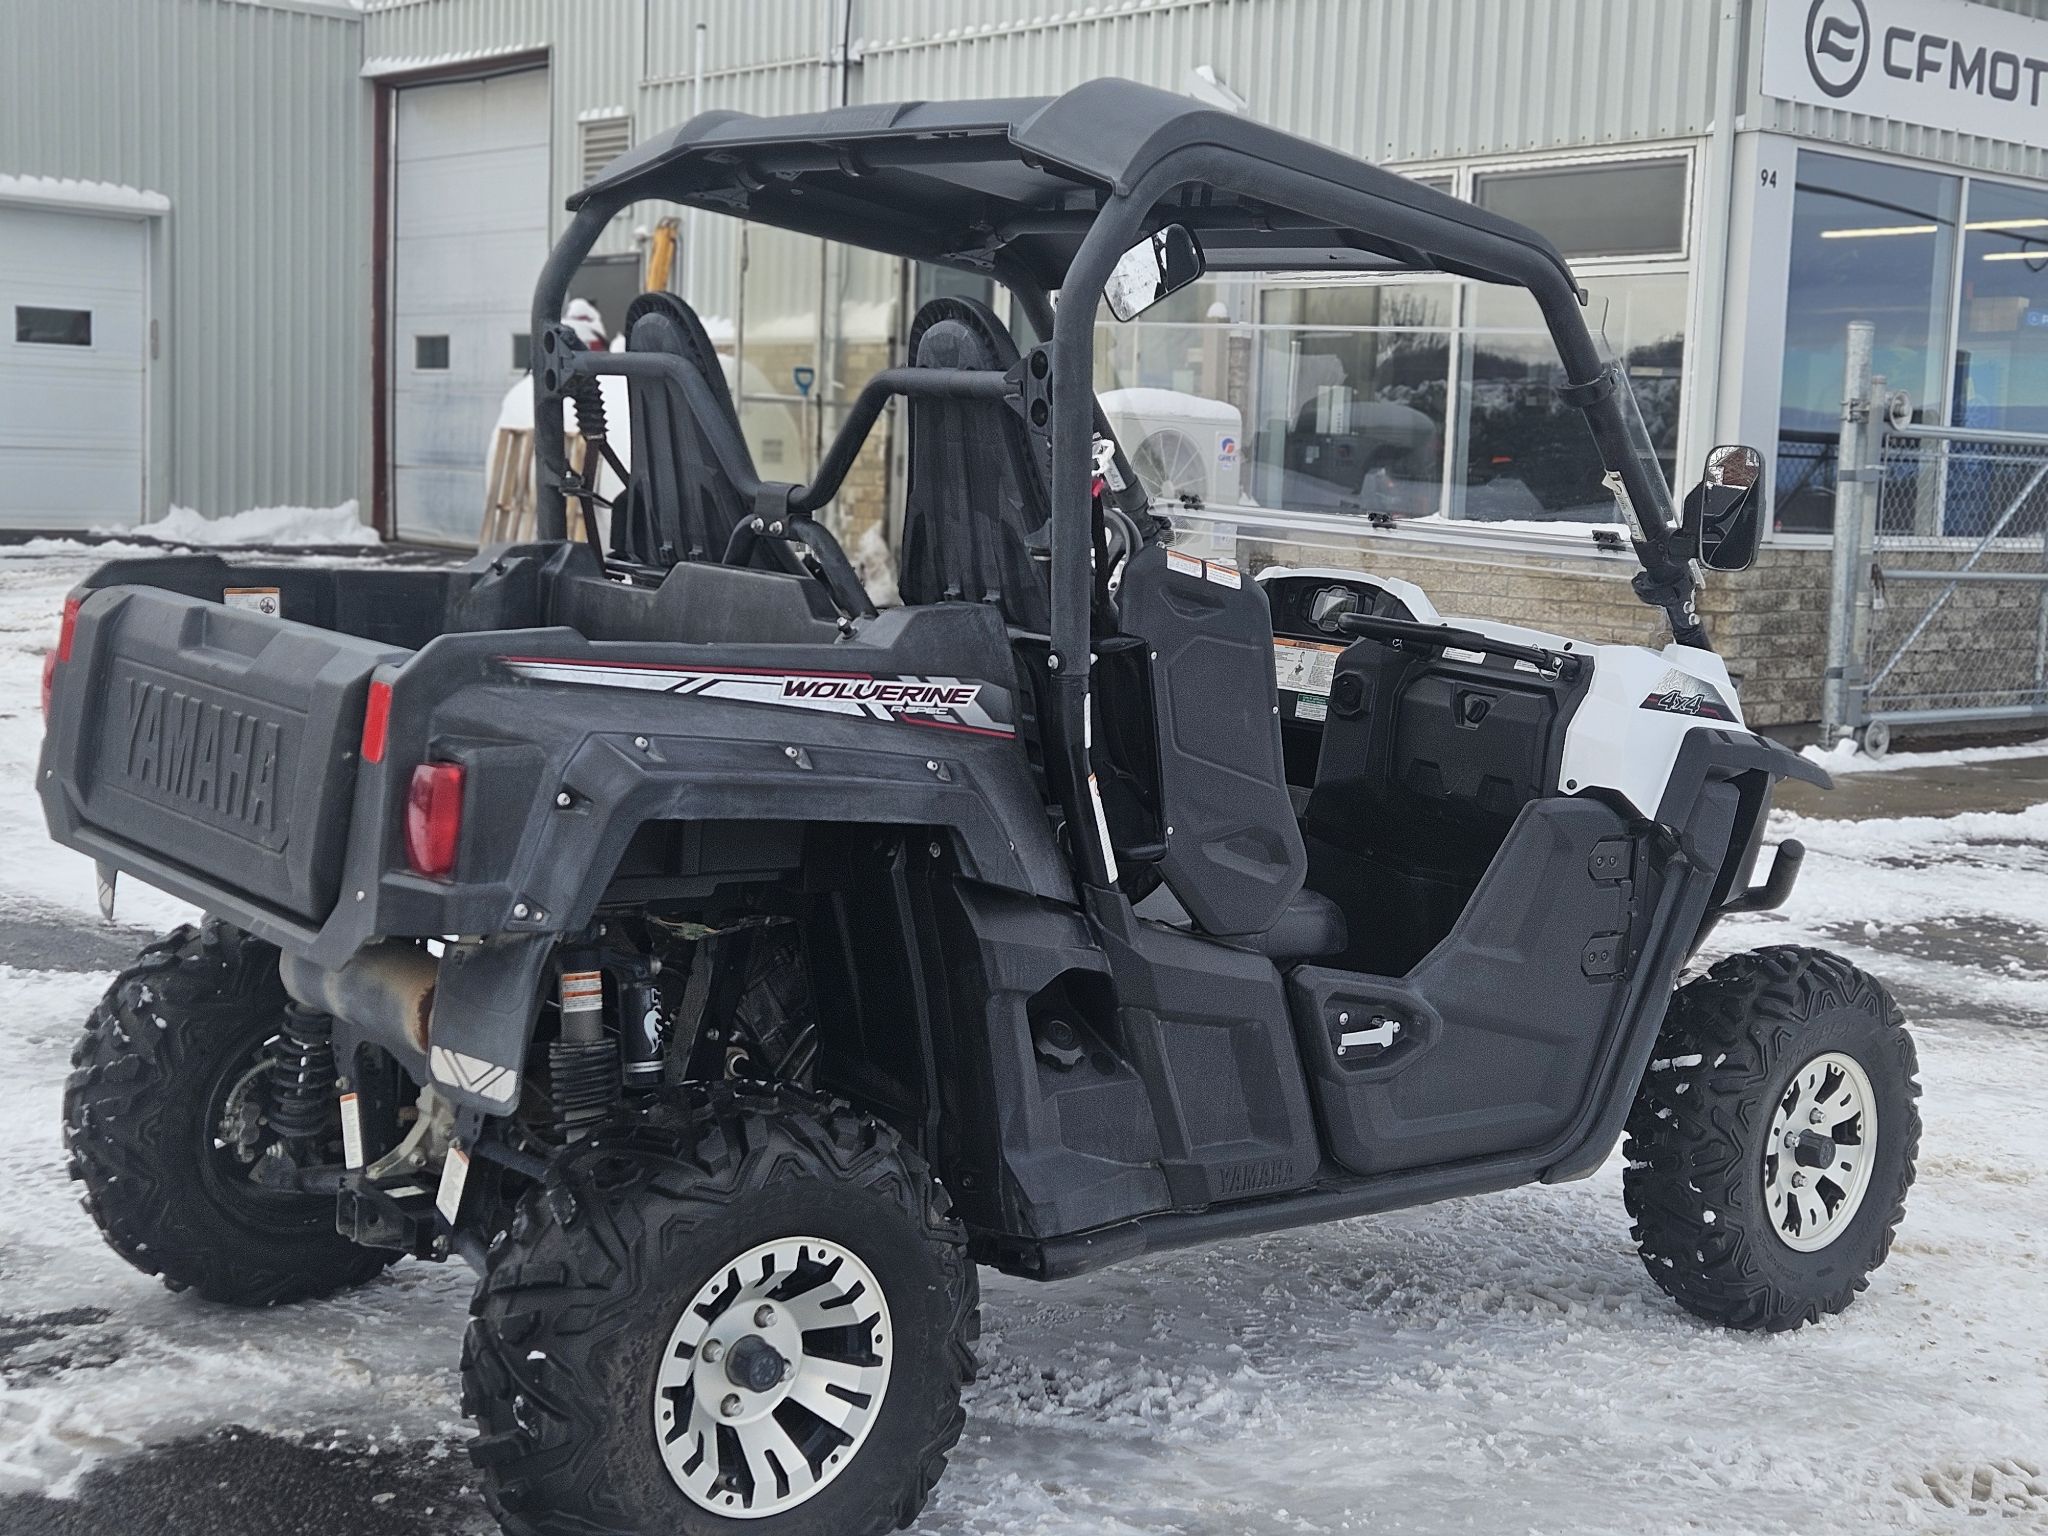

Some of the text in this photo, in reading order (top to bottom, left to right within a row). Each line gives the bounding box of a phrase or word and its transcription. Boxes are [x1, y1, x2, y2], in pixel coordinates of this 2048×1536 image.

[1882, 26, 2048, 107] CFMOT
[1760, 168, 1777, 189] 94
[782, 679, 978, 705] WOLVERINE
[1658, 690, 1704, 714] 4x4
[125, 677, 281, 832] YAMAHA
[1218, 1160, 1293, 1194] YAMAHA
